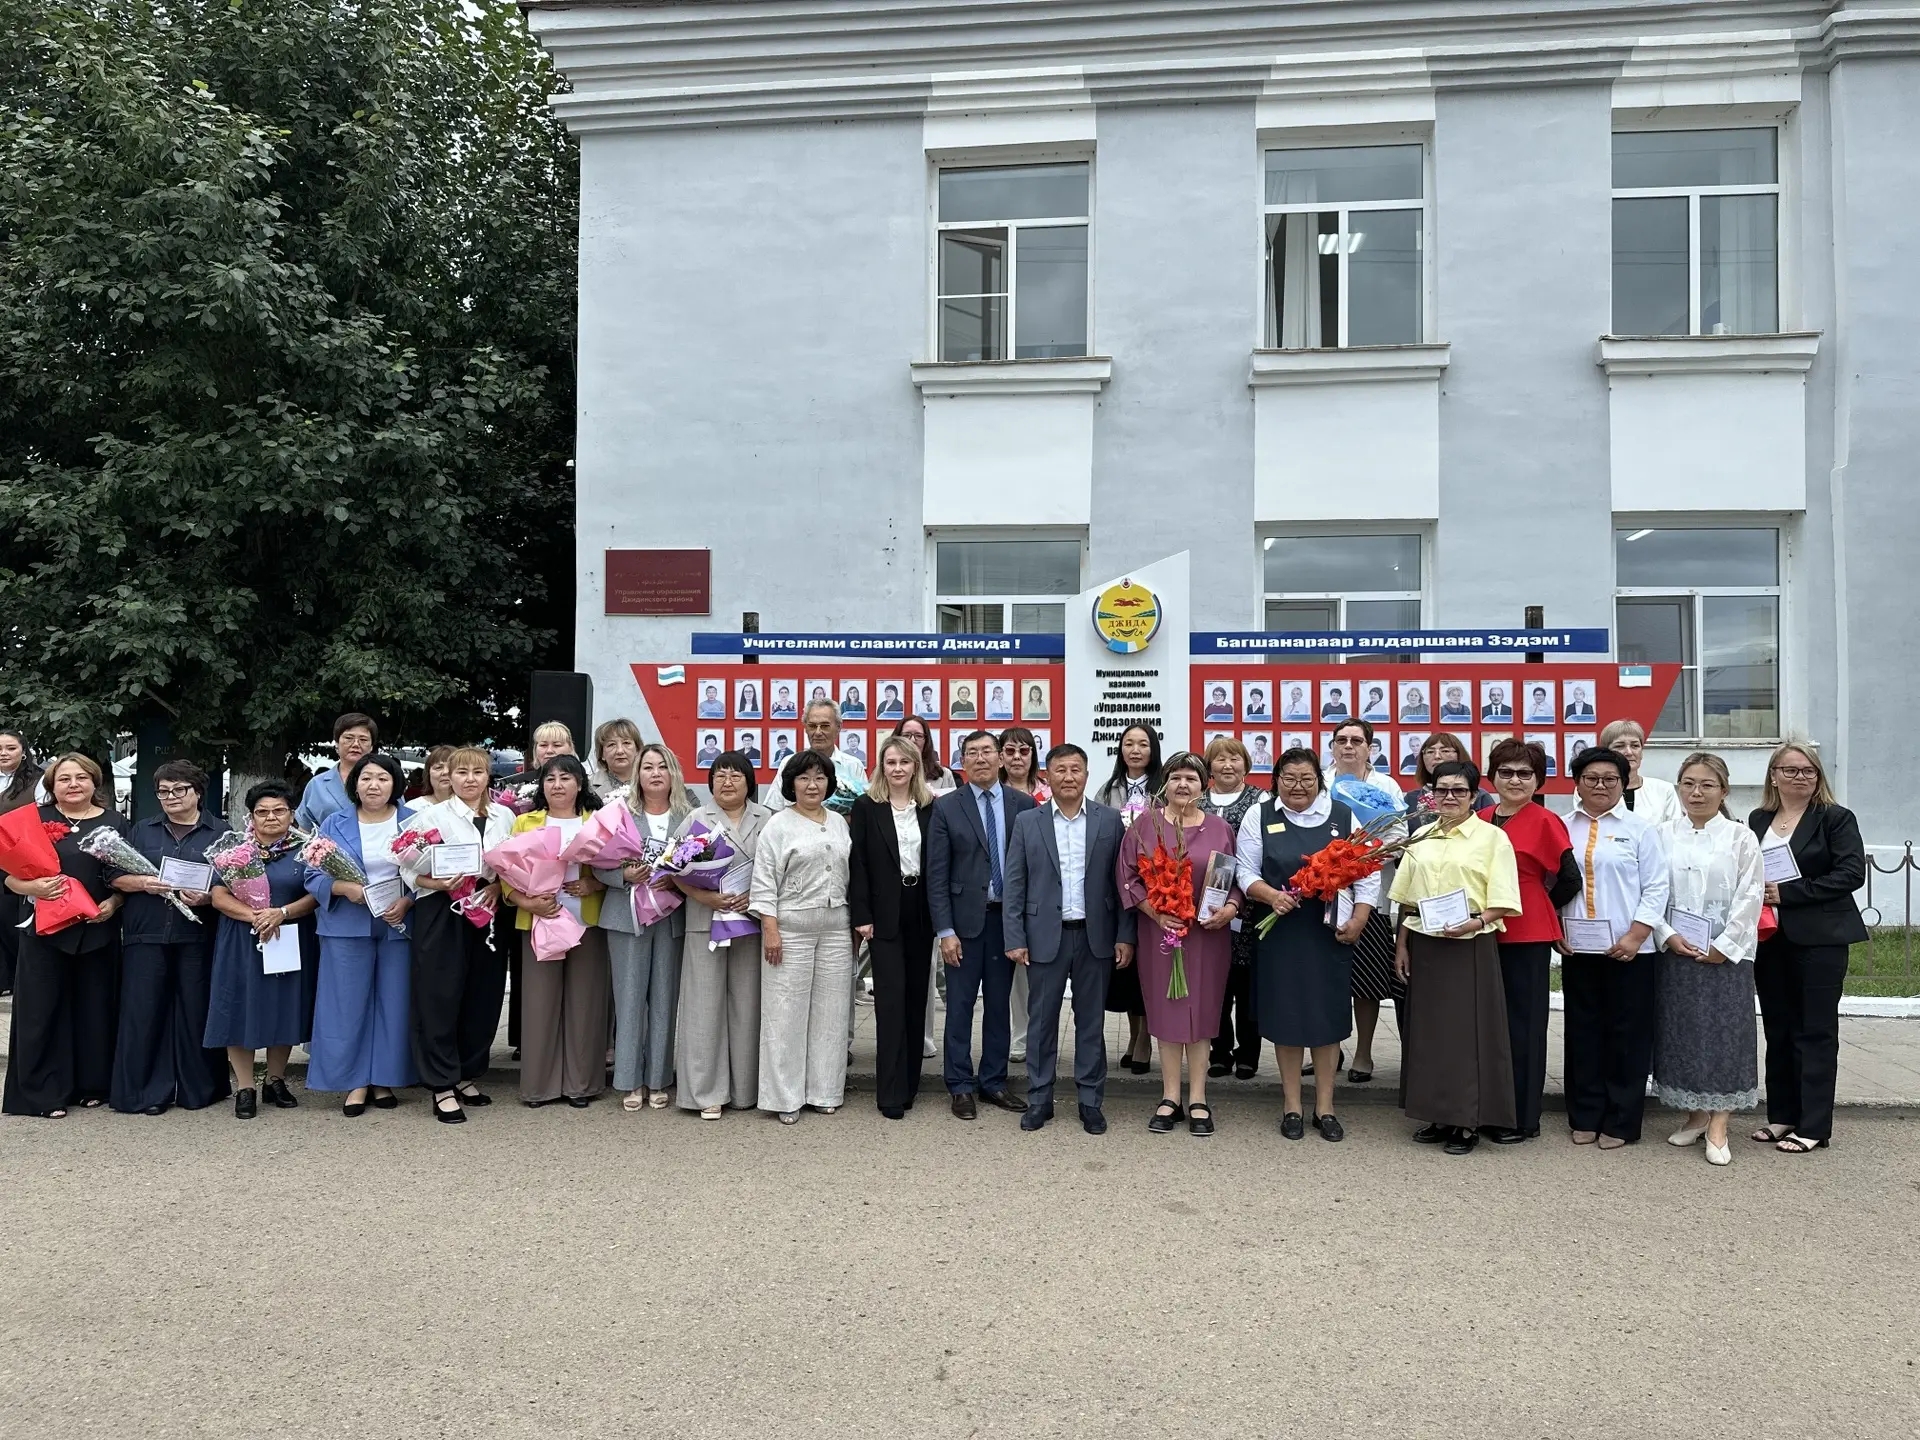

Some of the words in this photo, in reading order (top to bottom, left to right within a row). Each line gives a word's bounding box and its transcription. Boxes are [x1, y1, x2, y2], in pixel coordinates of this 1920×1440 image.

[1107, 619, 1148, 629] ДЖИДА
[742, 637, 846, 650] Учителями
[849, 638, 939, 650] славится
[941, 638, 1011, 651] Джида
[1216, 636, 1354, 649] Багшанараар
[1358, 636, 1484, 648] алдаршана
[1487, 634, 1560, 648] Зэдэм
[1095, 669, 1159, 678] Муниципальное
[1108, 680, 1146, 688] казенное
[1102, 691, 1152, 700] учреждение
[1093, 702, 1161, 714] «Управление
[1093, 716, 1162, 728] образования
